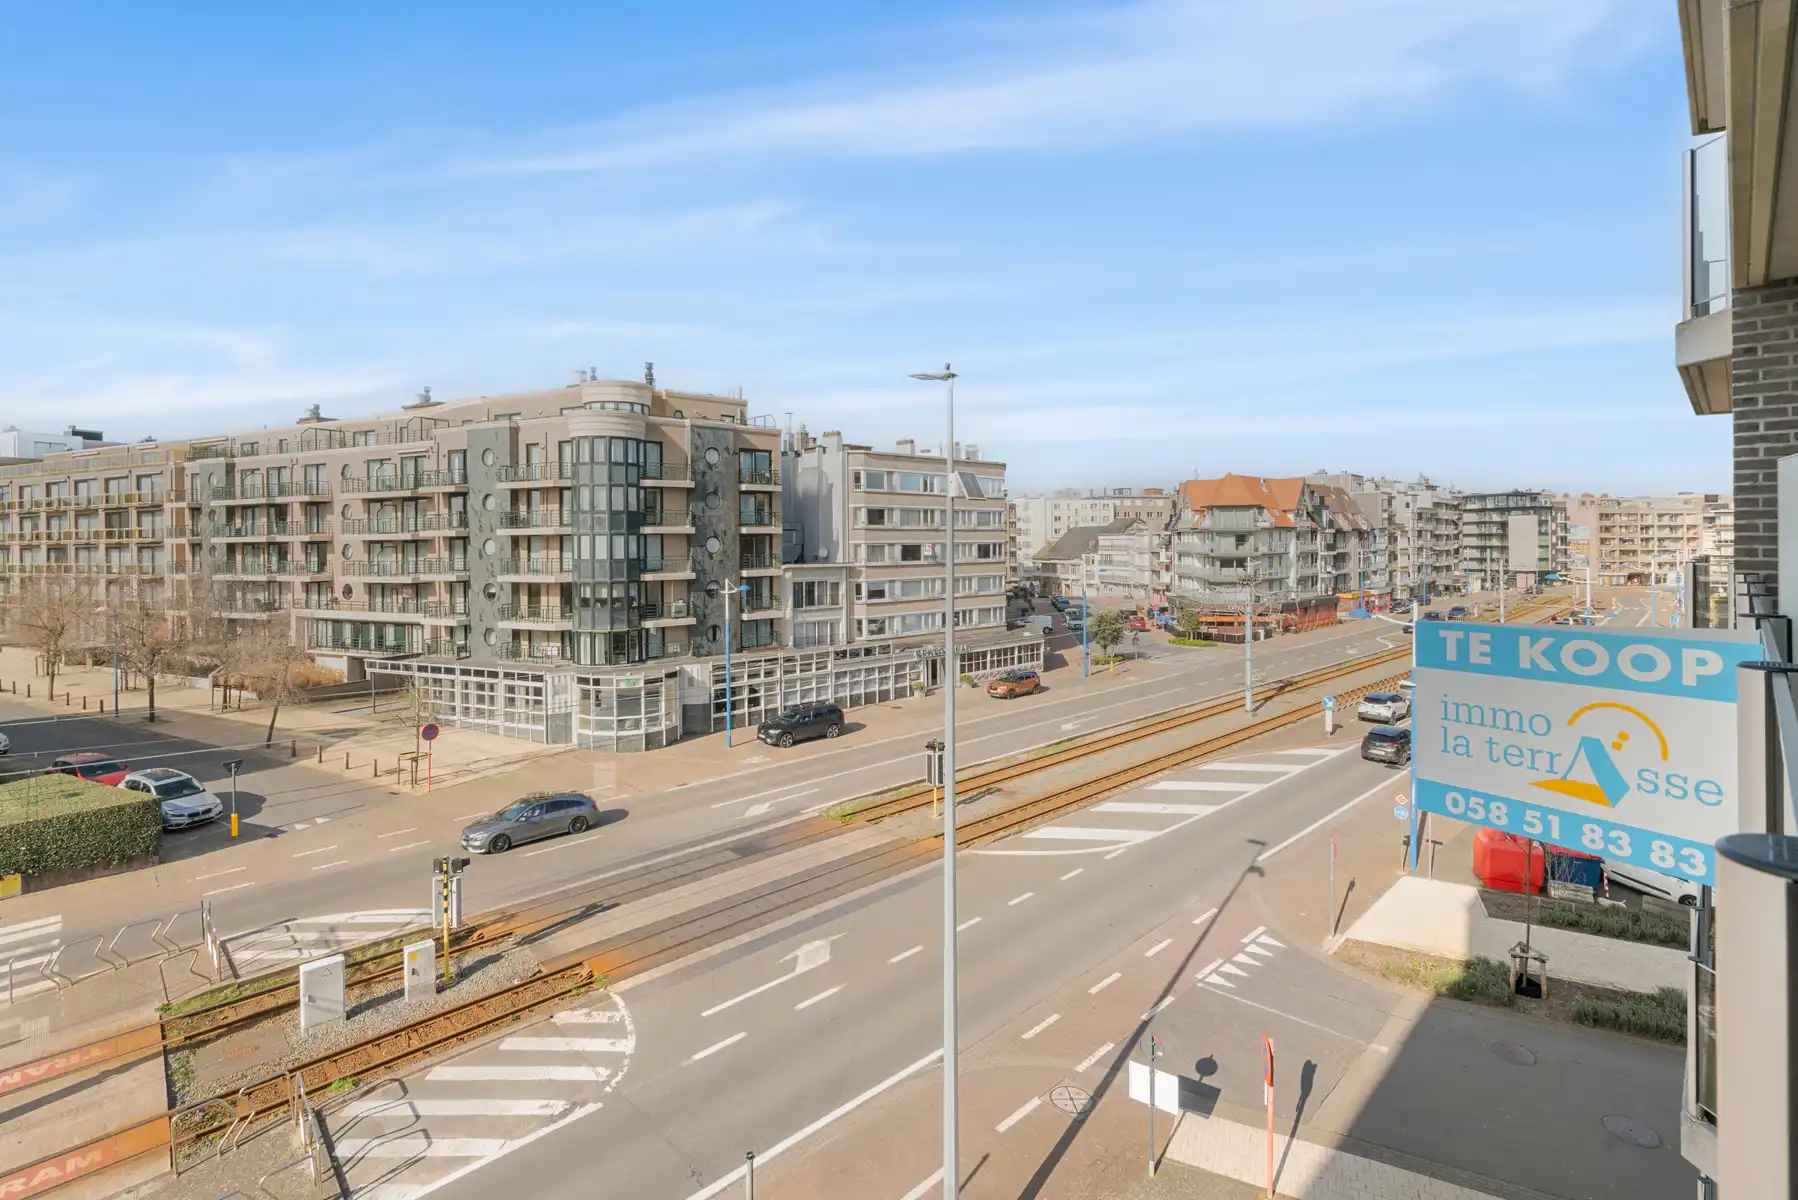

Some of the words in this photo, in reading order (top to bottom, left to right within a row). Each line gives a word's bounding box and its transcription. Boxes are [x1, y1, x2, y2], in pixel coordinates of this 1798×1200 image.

[1439, 630, 1491, 664] TE
[1519, 636, 1723, 686] KOOP
[1440, 694, 1552, 737] immo
[1440, 726, 1474, 758] la
[1445, 792, 1508, 826] 058
[1523, 809, 1560, 839] 51
[1582, 823, 1632, 857] 83
[1650, 840, 1707, 877] 83
